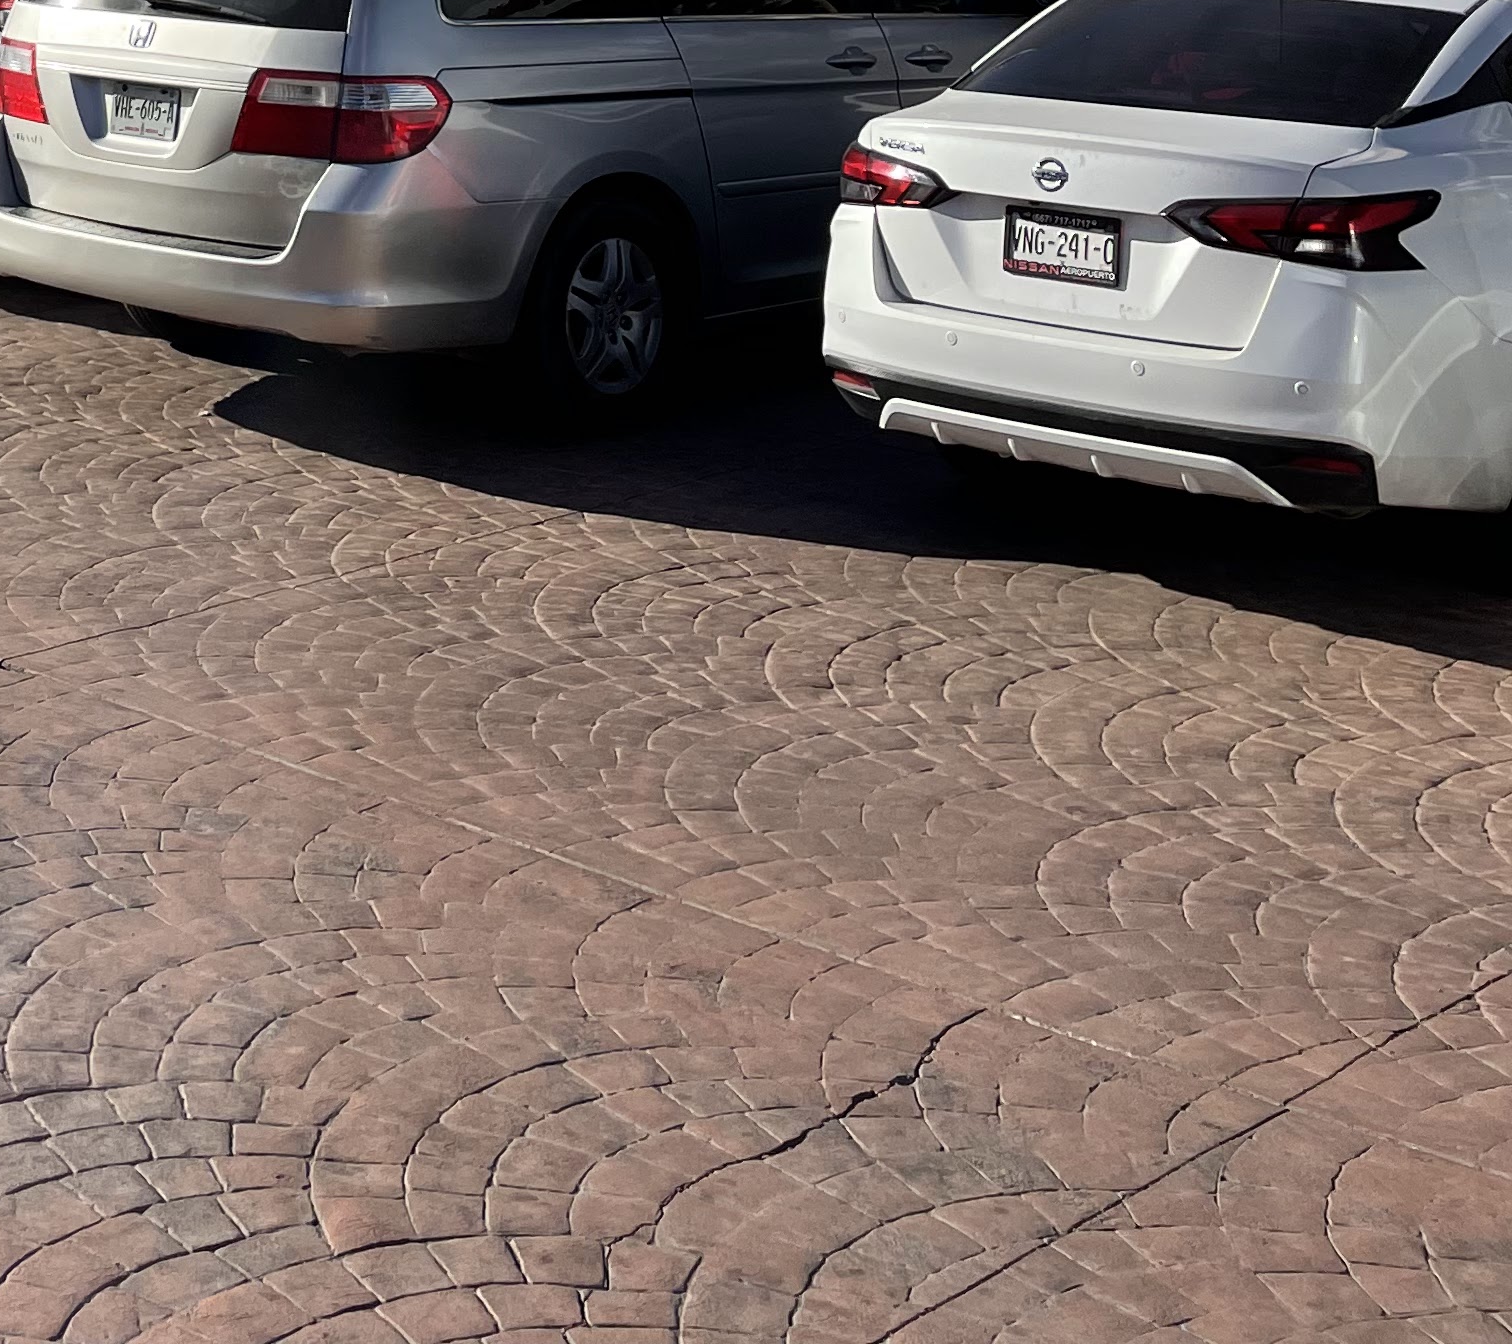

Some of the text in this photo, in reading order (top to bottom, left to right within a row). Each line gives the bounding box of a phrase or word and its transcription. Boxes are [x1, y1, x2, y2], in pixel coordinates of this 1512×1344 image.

[114, 95, 174, 124] VHE-605-A
[1003, 258, 1116, 281] NISSAN AEROPUERTO
